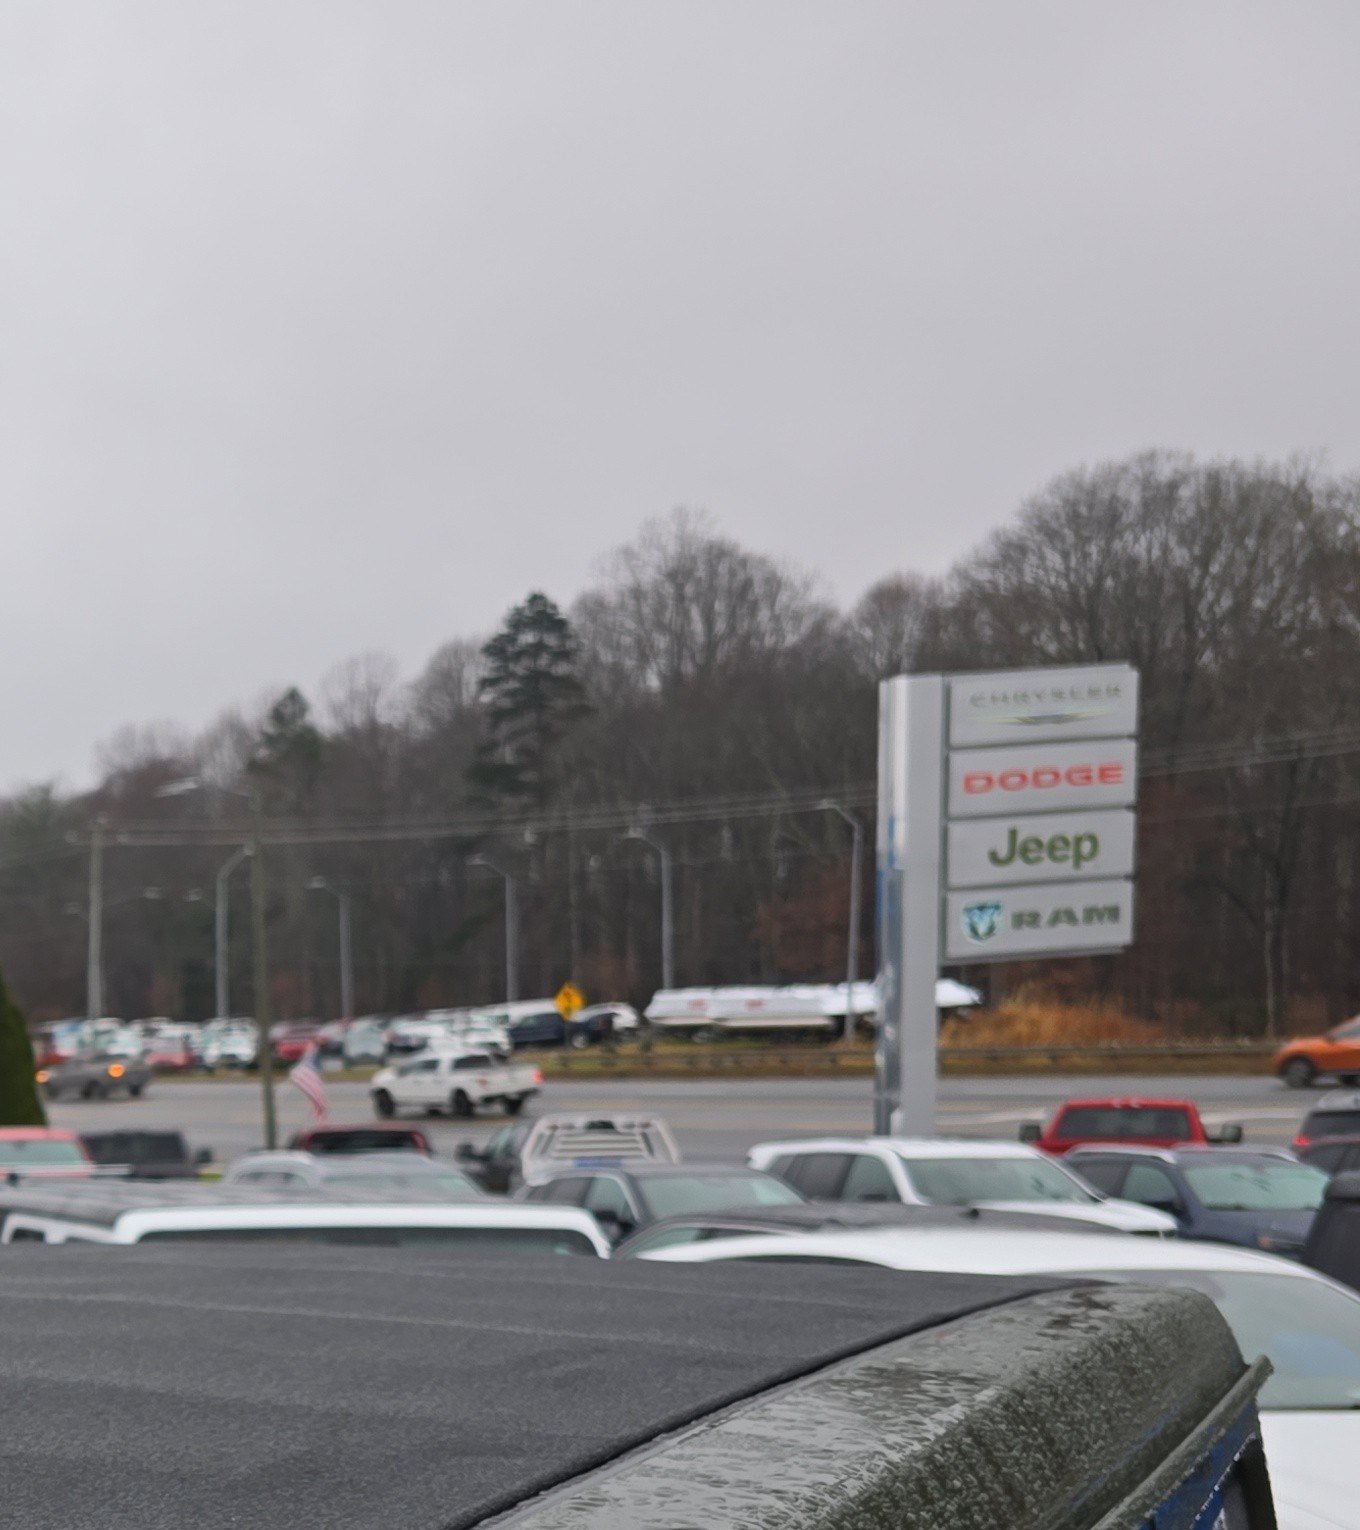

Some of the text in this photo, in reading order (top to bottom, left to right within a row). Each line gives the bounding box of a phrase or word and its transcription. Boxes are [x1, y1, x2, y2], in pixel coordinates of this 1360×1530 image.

[963, 763, 1125, 794] DODGE
[987, 827, 1100, 869] Jeep
[1011, 905, 1121, 930] RAM
